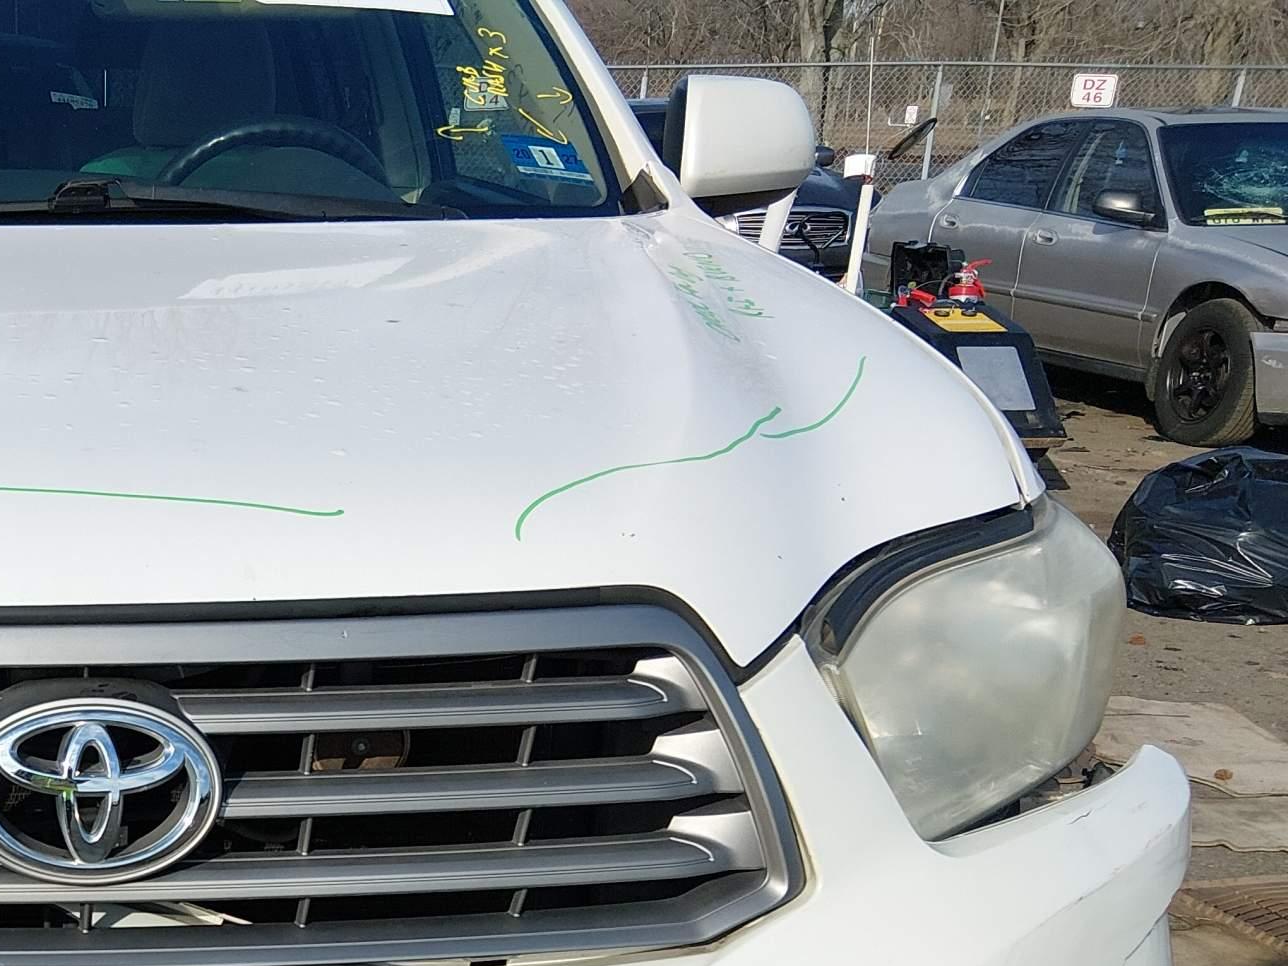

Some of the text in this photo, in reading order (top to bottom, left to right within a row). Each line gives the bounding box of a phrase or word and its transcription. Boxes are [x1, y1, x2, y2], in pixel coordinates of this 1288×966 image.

[477, 27, 507, 44] 3
[1082, 79, 1108, 91] DZ
[1081, 92, 1103, 103] 46
[538, 149, 554, 166] 1
